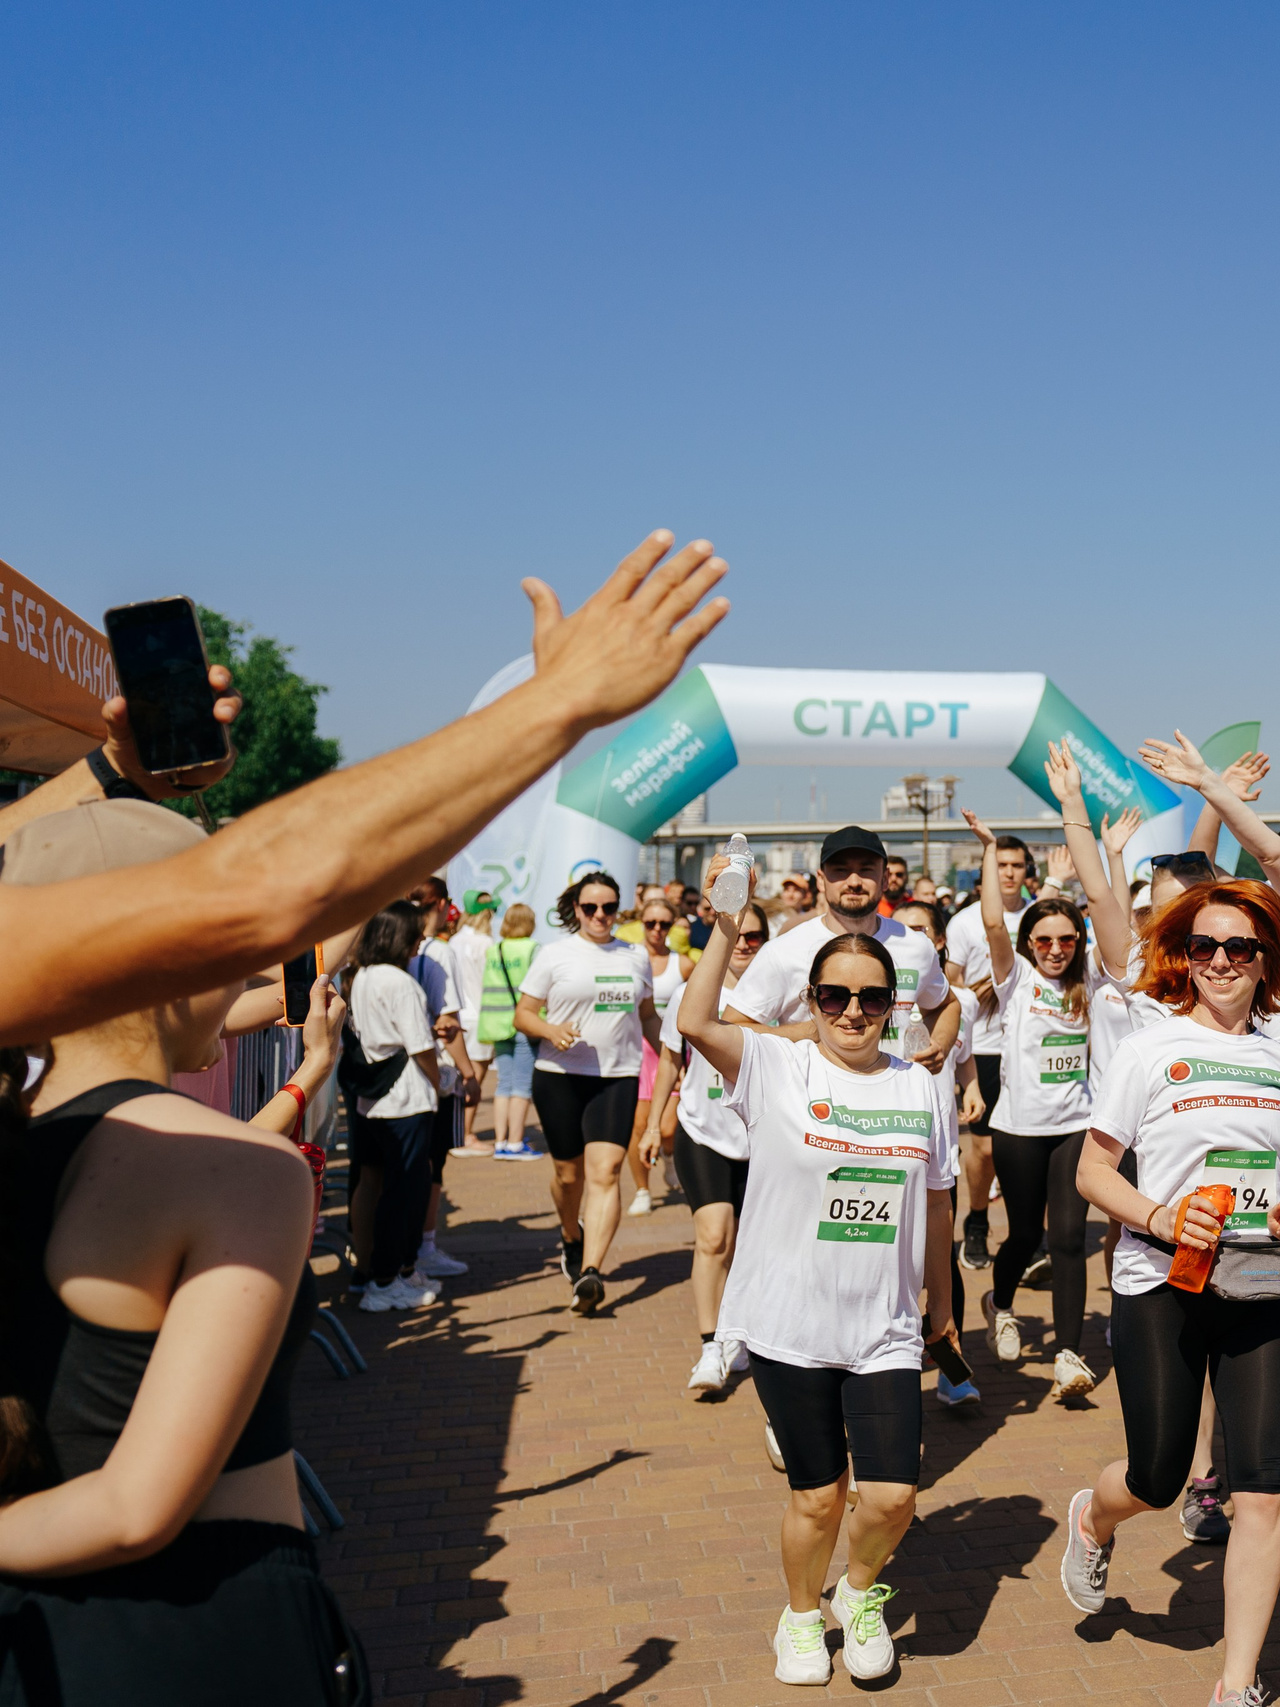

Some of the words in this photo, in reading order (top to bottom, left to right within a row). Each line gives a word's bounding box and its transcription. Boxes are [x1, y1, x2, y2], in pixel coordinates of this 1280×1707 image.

[12, 589, 49, 664] БЕЗ
[793, 698, 970, 739] СТАРТ
[610, 720, 693, 793] зелёный
[624, 737, 705, 808] марафон
[598, 990, 631, 1002] 0545
[1047, 1055, 1081, 1071] 1092
[1196, 1062, 1257, 1078] Профит
[1176, 1099, 1216, 1112] Всегда
[1217, 1096, 1257, 1108] Желать
[893, 1115, 928, 1130] Лига
[808, 1135, 846, 1153] Всегда
[848, 1143, 890, 1156] Желать
[829, 1198, 890, 1222] 0524
